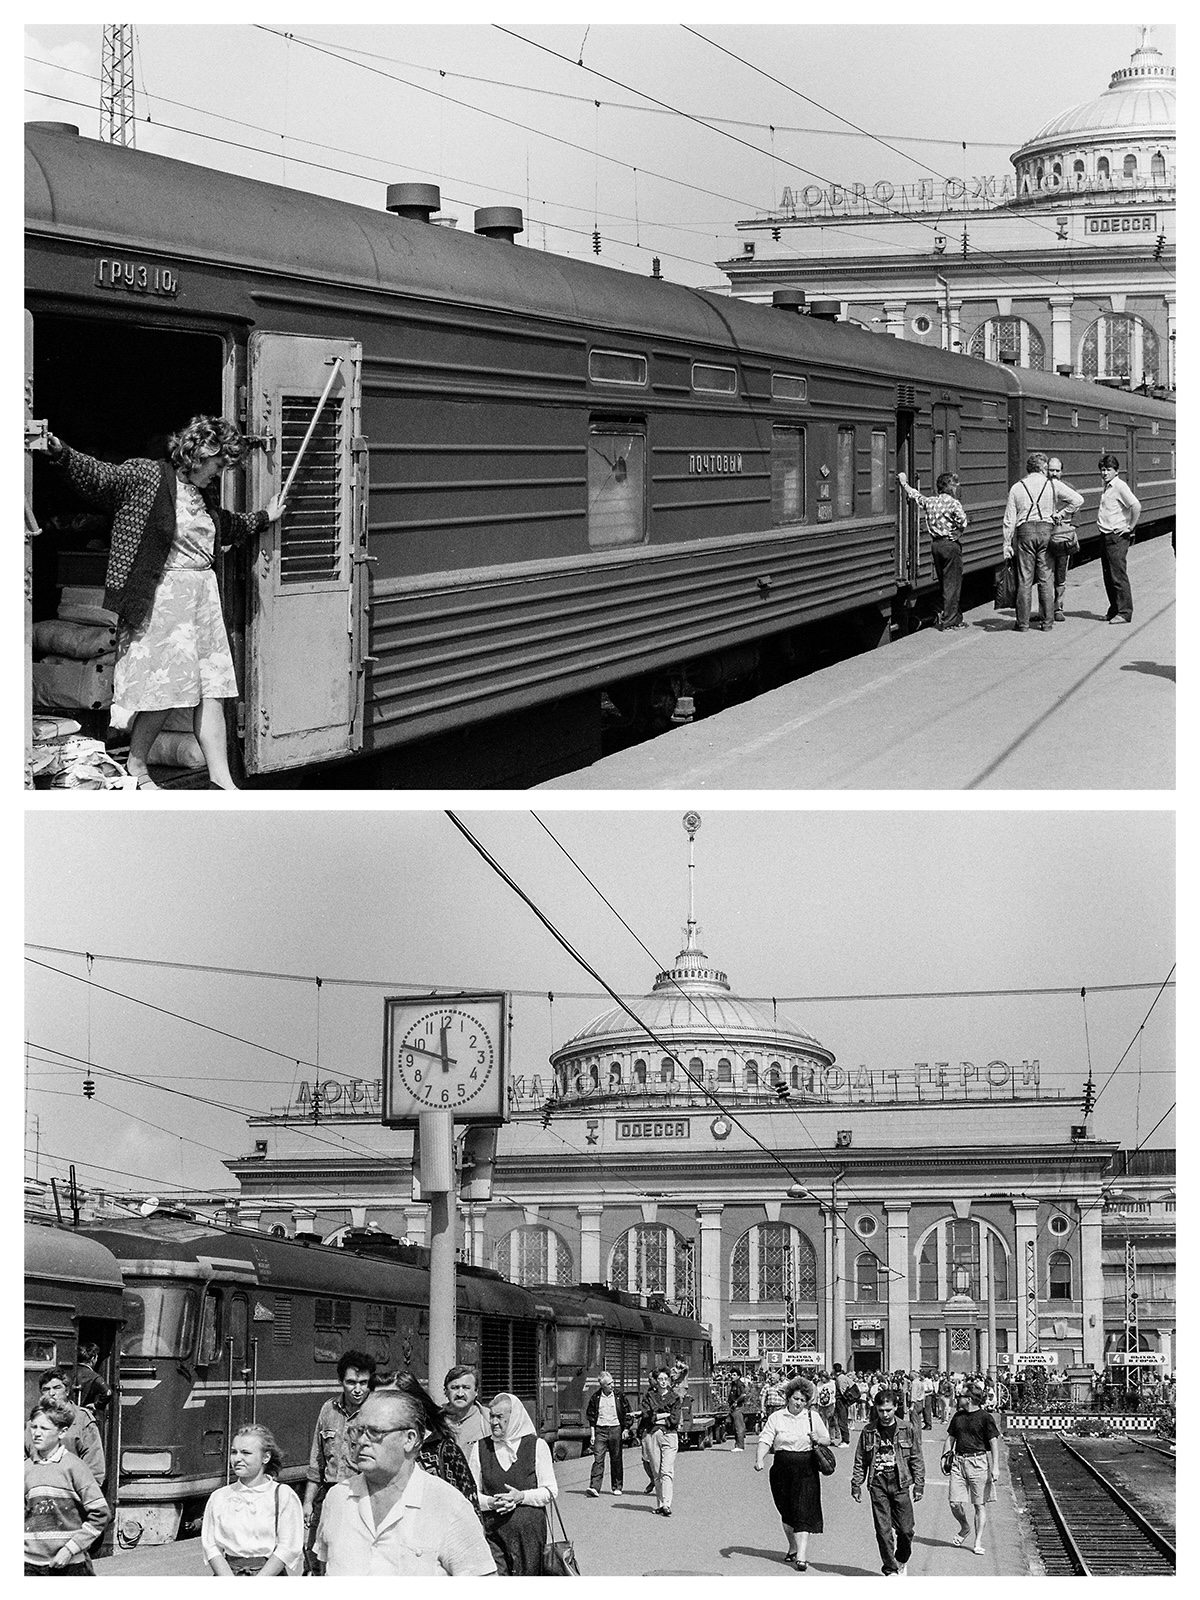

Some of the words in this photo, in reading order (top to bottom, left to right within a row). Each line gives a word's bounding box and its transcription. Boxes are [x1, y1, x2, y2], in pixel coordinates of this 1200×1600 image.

[779, 180, 895, 208] ДОБРО
[918, 167, 1146, 200] ПОЖАЛОВАТЬ
[1090, 218, 1151, 233] ОДЕССА
[100, 259, 147, 287] ГРУЗ
[689, 453, 743, 473] ПОЧТОВЫЙ
[425, 1021, 433, 1035] 11
[441, 1016, 452, 1029] 12
[414, 1038, 426, 1051] 10
[469, 1035, 477, 1048] 2
[406, 1054, 414, 1067] 9
[477, 1050, 485, 1064] 3
[414, 1069, 422, 1082] 8
[469, 1067, 478, 1080] 4
[705, 1069, 720, 1093] В
[425, 1085, 433, 1098] 7
[441, 1089, 449, 1102] 6
[457, 1084, 466, 1097] 5
[621, 1122, 685, 1137] ОДЕССА
[771, 1354, 779, 1363] 3
[1002, 1354, 1010, 1363] 3
[1113, 1354, 1120, 1363] 4
